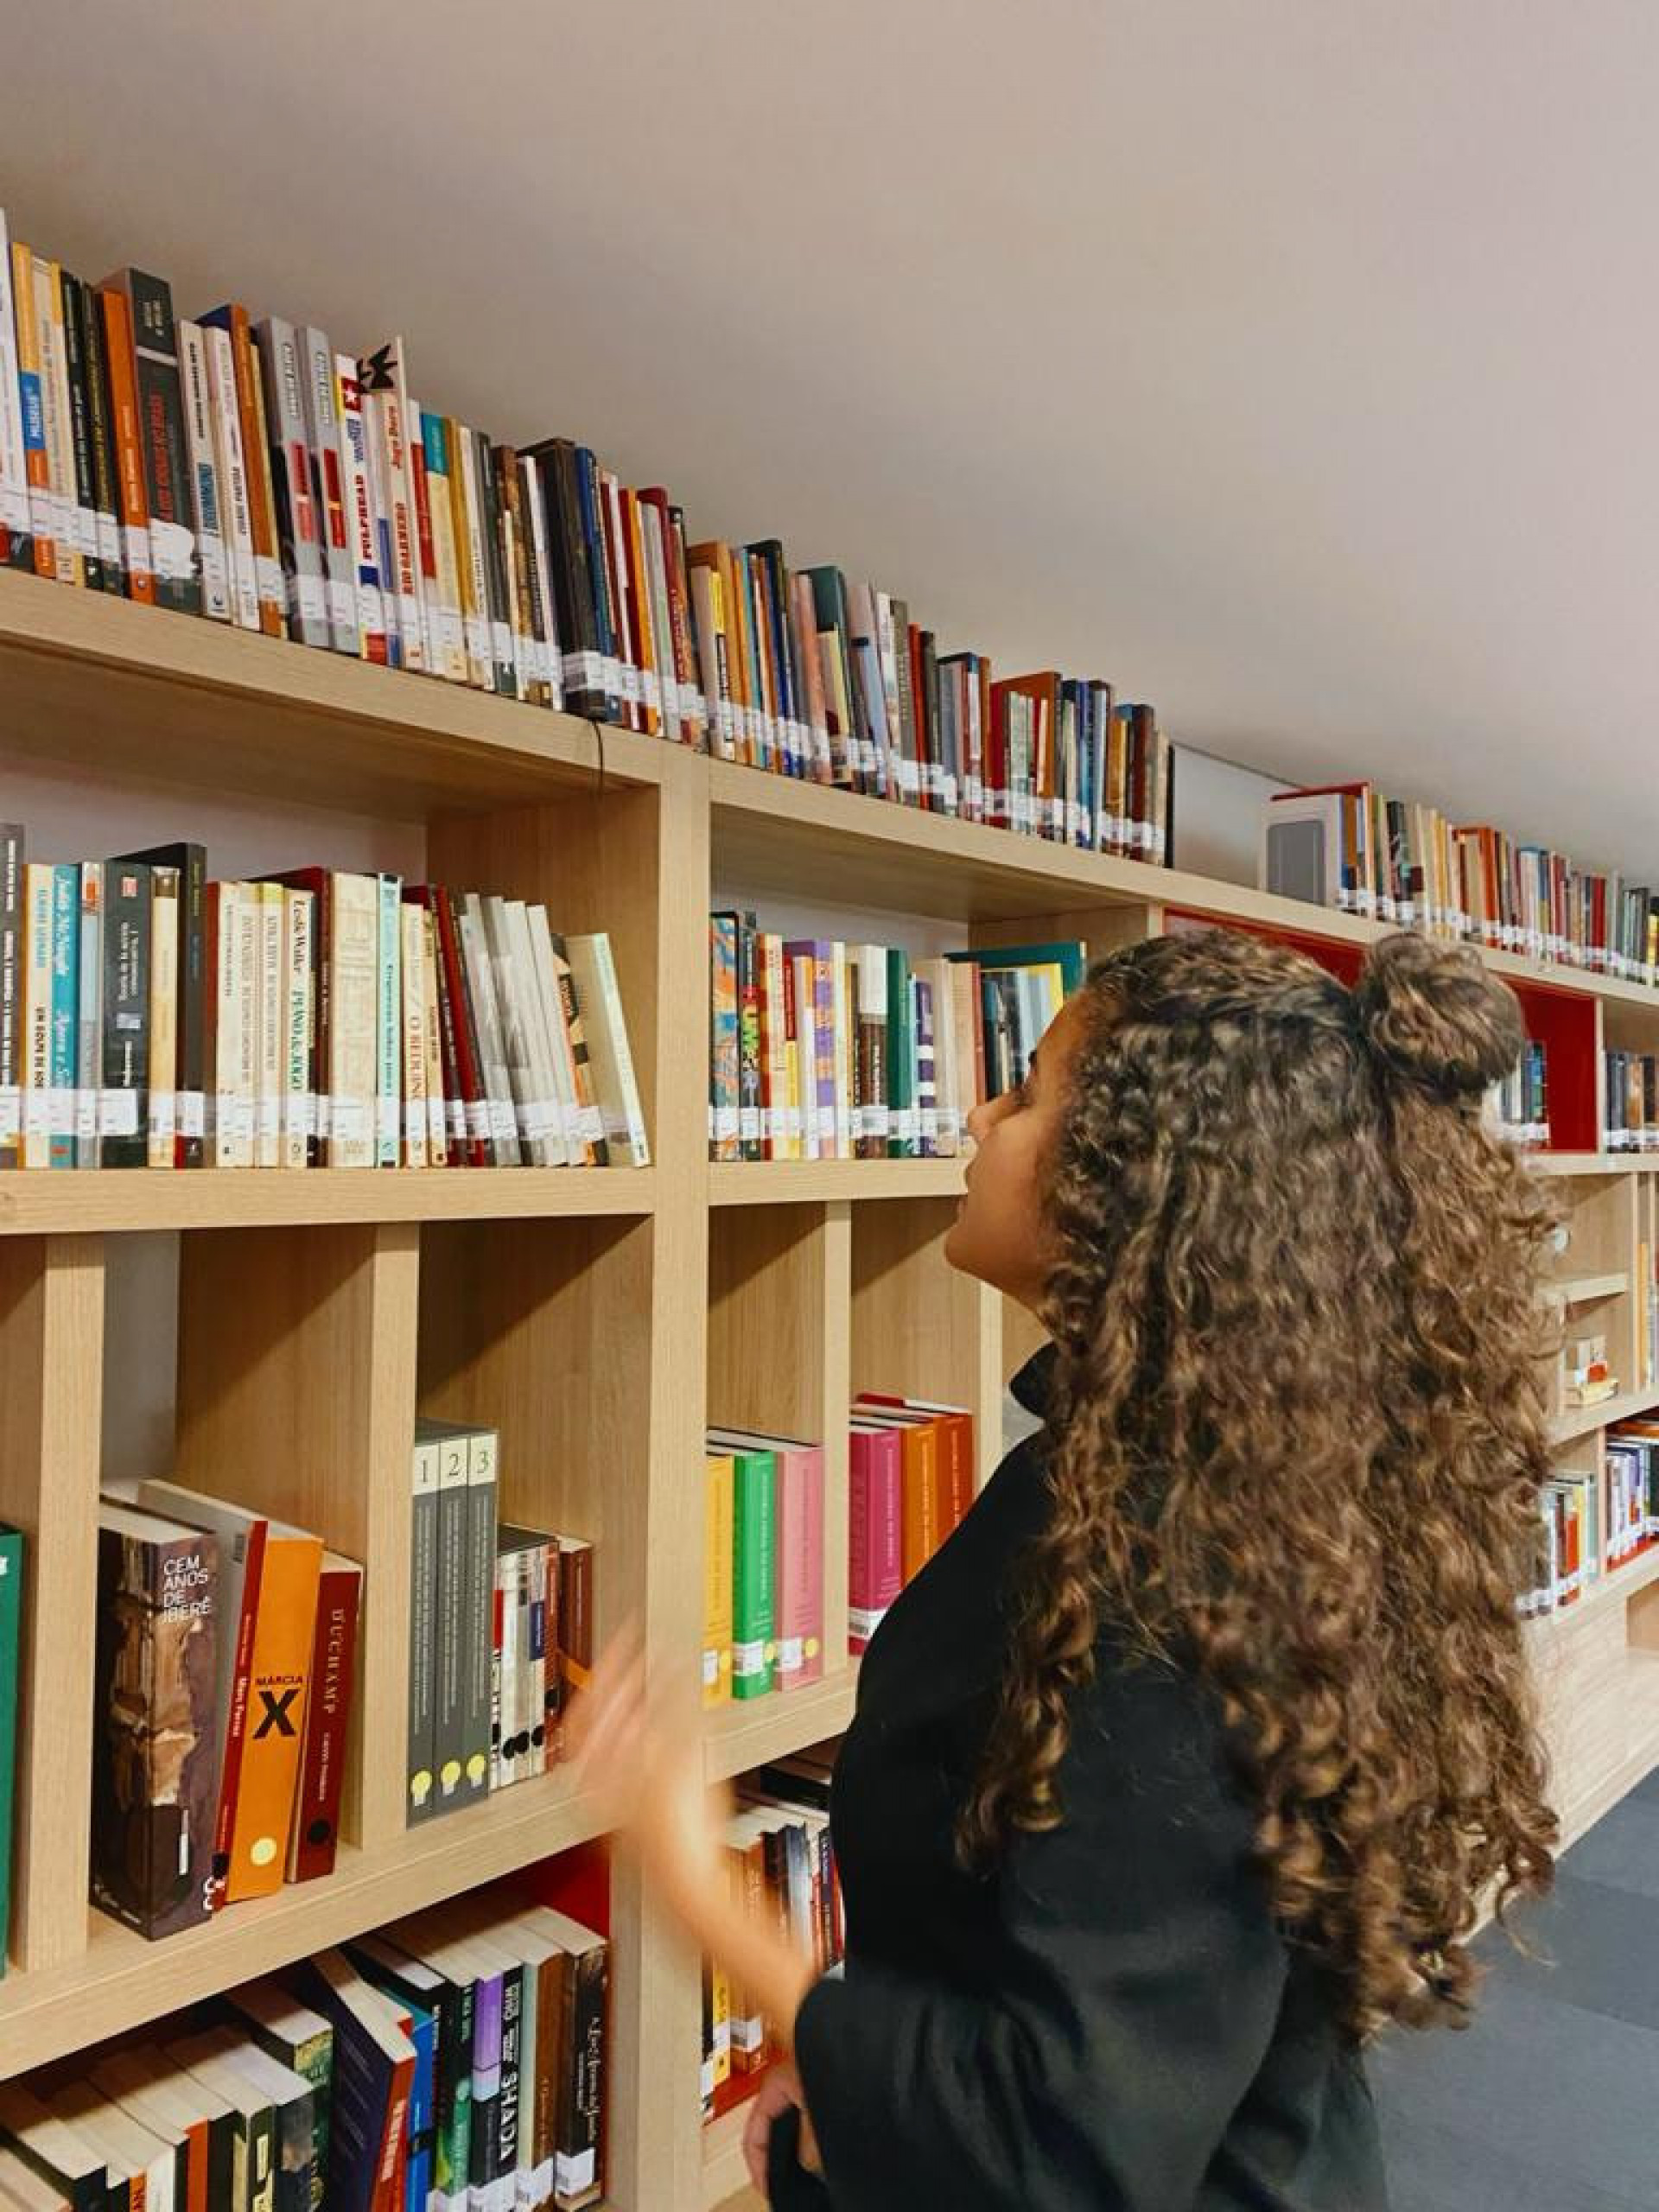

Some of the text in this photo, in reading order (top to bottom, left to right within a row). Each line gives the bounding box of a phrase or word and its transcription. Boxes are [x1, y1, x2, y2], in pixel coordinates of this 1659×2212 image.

[354, 474, 372, 560] PULPHEAD
[422, 1459, 429, 1484] 1
[448, 1453, 459, 1477] 2
[477, 1452, 489, 1474] 3
[164, 1554, 200, 1575] CEM
[164, 1568, 207, 1590] ANOS
[164, 1590, 187, 1607] DE
[323, 1608, 346, 1714] DUCHAMP
[252, 1688, 301, 1739] X
